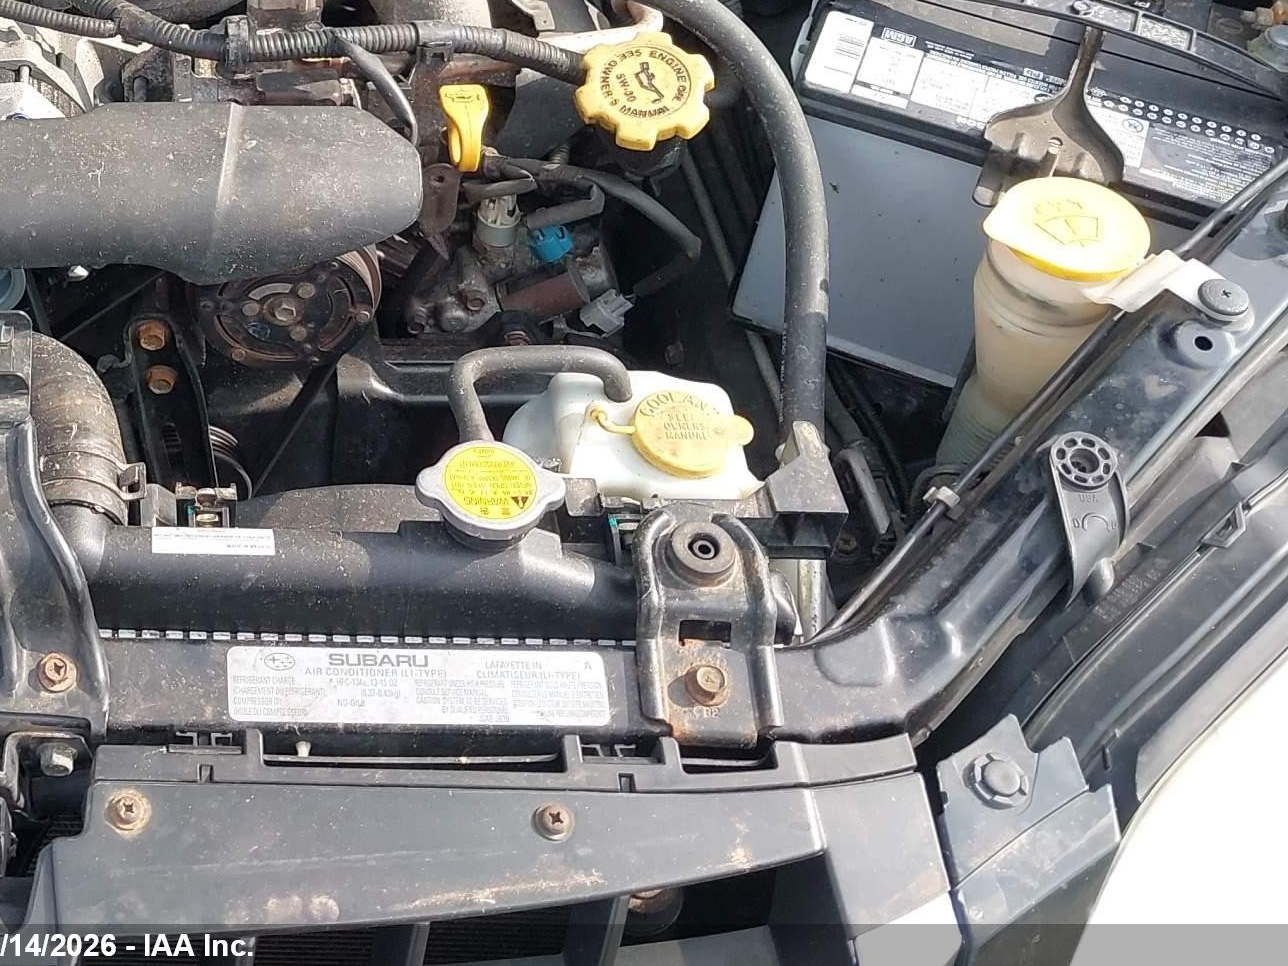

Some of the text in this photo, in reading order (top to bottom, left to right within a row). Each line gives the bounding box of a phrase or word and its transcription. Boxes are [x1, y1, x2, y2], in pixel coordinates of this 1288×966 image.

[884, 30, 915, 46] AGM
[648, 50, 687, 84] ENGINE
[600, 49, 670, 118] SEE OWNER'S MANUAL
[463, 495, 510, 506] WARNING
[328, 653, 428, 668] SUBARU
[304, 667, 323, 675] AIR
[325, 667, 398, 677] CONDITIONER
[476, 670, 537, 680] CLIMATISEUR
